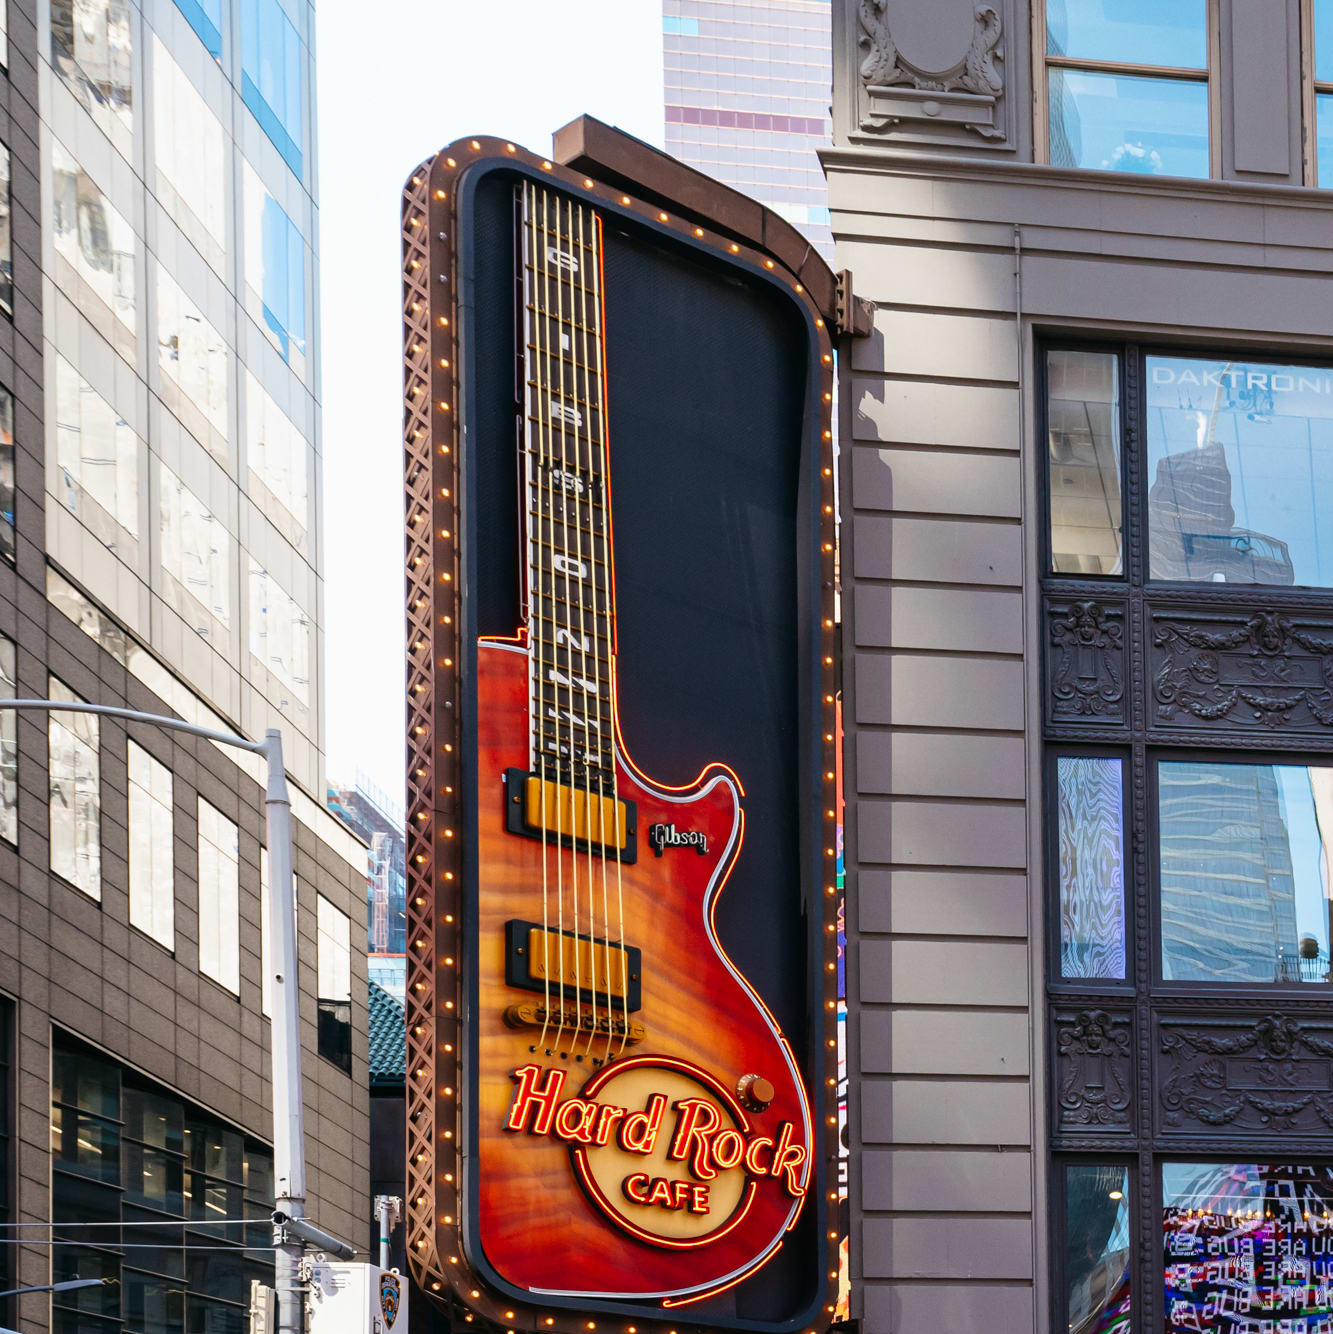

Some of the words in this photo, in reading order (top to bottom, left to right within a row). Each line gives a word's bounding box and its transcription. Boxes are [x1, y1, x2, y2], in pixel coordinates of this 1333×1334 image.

[654, 824, 709, 853] Gibson
[505, 1063, 668, 1154] Hard
[668, 1097, 807, 1198] Rock
[622, 1173, 710, 1215] CAFE
